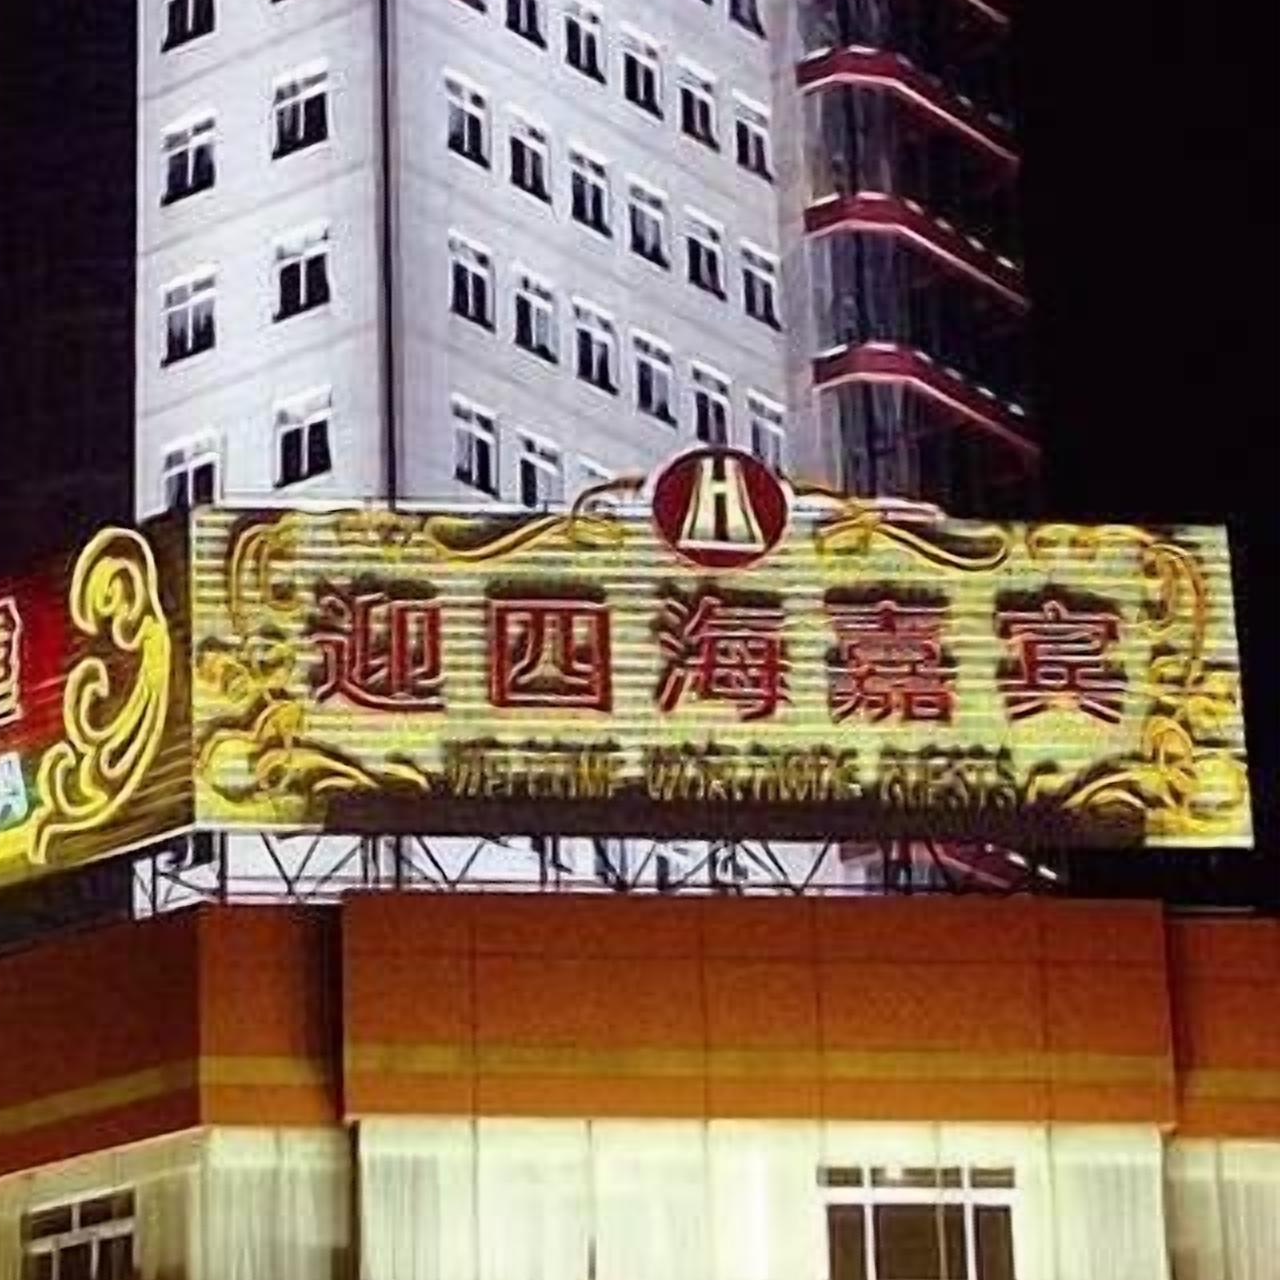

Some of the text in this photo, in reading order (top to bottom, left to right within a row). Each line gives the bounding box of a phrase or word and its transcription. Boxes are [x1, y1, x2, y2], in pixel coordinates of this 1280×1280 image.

[310, 590, 1128, 721] 迎四海嘉宾
